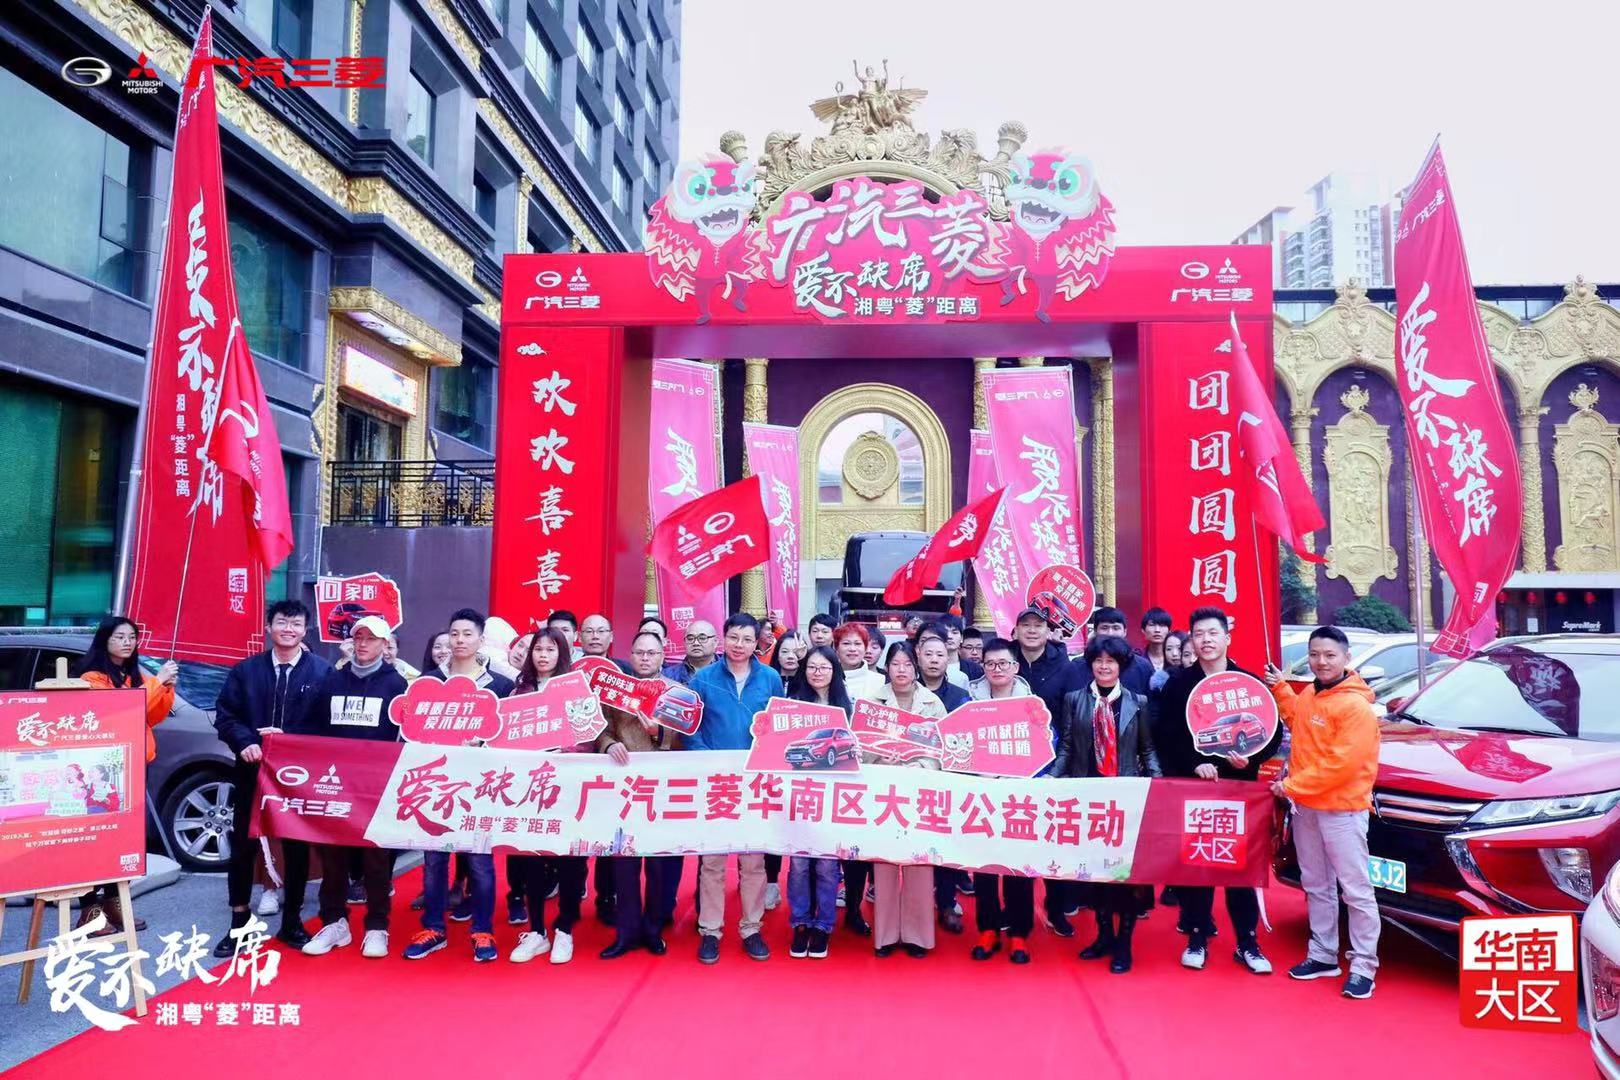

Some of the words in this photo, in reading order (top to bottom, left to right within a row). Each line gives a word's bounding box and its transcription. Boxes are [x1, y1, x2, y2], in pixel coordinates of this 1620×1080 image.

[767, 183, 1006, 281] 广汽三菱
[793, 251, 931, 318] 爱不缺席
[1170, 288, 1253, 302] 广汽三菱
[524, 296, 600, 310] 广汽三菱
[853, 296, 978, 315] 湘粤“菱”距离
[1400, 281, 1503, 548] 爱不缺席
[522, 370, 578, 630] 欢欢喜喜
[1188, 370, 1237, 630] 团团圆圆
[597, 672, 636, 694] 家的味道
[16, 710, 101, 746] 爱不缺席
[423, 716, 485, 730] 爱不缺席
[500, 704, 549, 726] 汽三菱
[977, 722, 1031, 740] 爱不缺席
[260, 794, 353, 818] 广汽三菱
[397, 754, 562, 836] 爱不缺席
[574, 772, 1126, 848] 广汽三菱华南区大型公益活动
[1188, 806, 1240, 834] 华南
[459, 814, 562, 836] 湘粤“菱”距离
[1188, 836, 1237, 864] 大区
